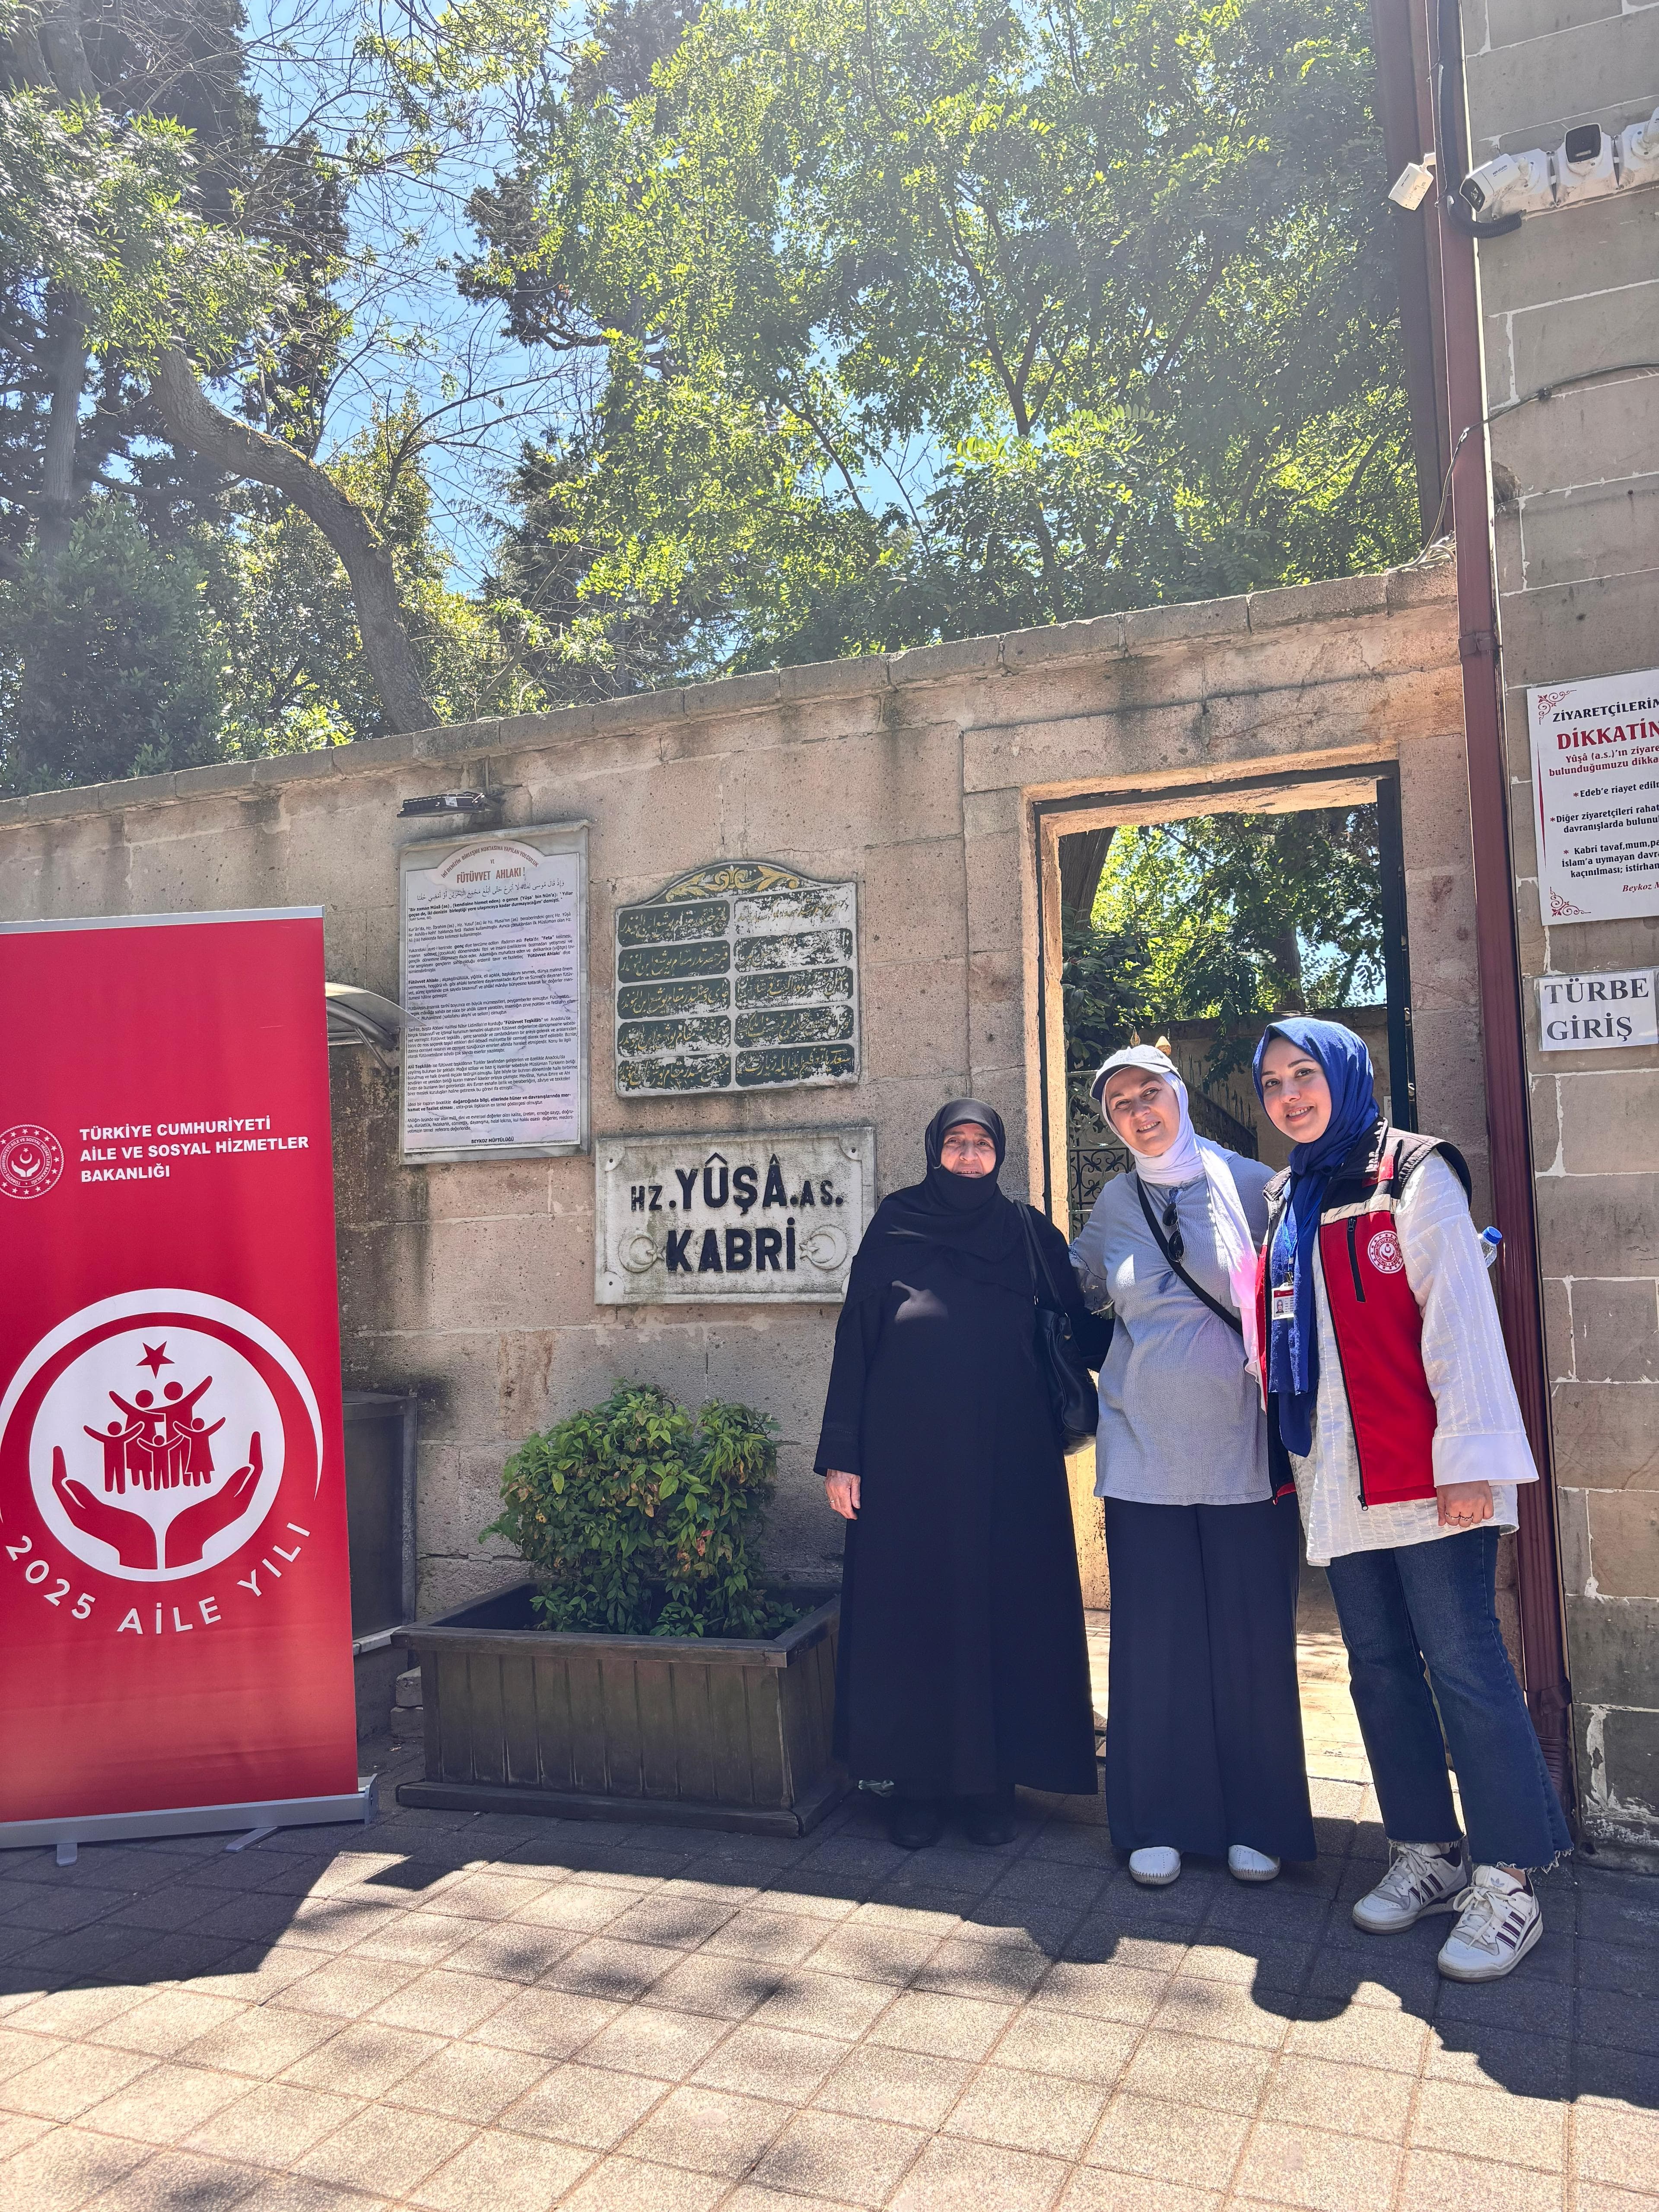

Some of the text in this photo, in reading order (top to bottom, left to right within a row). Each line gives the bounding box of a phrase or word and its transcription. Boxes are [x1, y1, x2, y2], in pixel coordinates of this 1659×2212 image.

[1565, 753, 1588, 764] Yûşâ
[1549, 760, 1629, 776] bulunduğumuzu
[1611, 783, 1637, 795] riayet
[1556, 814, 1579, 823] Diğer
[1581, 806, 1634, 821] ziyaretçileri
[1563, 820, 1624, 833] davranışlarda
[1574, 845, 1598, 855] Kabri
[447, 858, 461, 872] DENİZİN
[462, 848, 480, 860] BİRLEŞME
[504, 846, 519, 855] YAPILAN
[520, 851, 539, 868] YOLCULUK
[1595, 853, 1635, 865] uymayan
[456, 871, 491, 884] FÜTÜVVET
[496, 867, 521, 879] AHLAKI
[1570, 868, 1623, 879] kaçınılması;
[1622, 883, 1653, 893] Beykoz
[1544, 977, 1649, 1004] TÜRBE
[1547, 1012, 1633, 1042] GİRİŞ
[79, 1115, 271, 1141] TÜRKİYE CUMHURİYETİ
[80, 1136, 309, 1162] AİLE VE SOSYAL HİZMETLER
[81, 1163, 171, 1183] BAKANLIĞI
[666, 1216, 796, 1272] KABRİ
[5, 1522, 311, 1635] 2025 AİLE YILI
